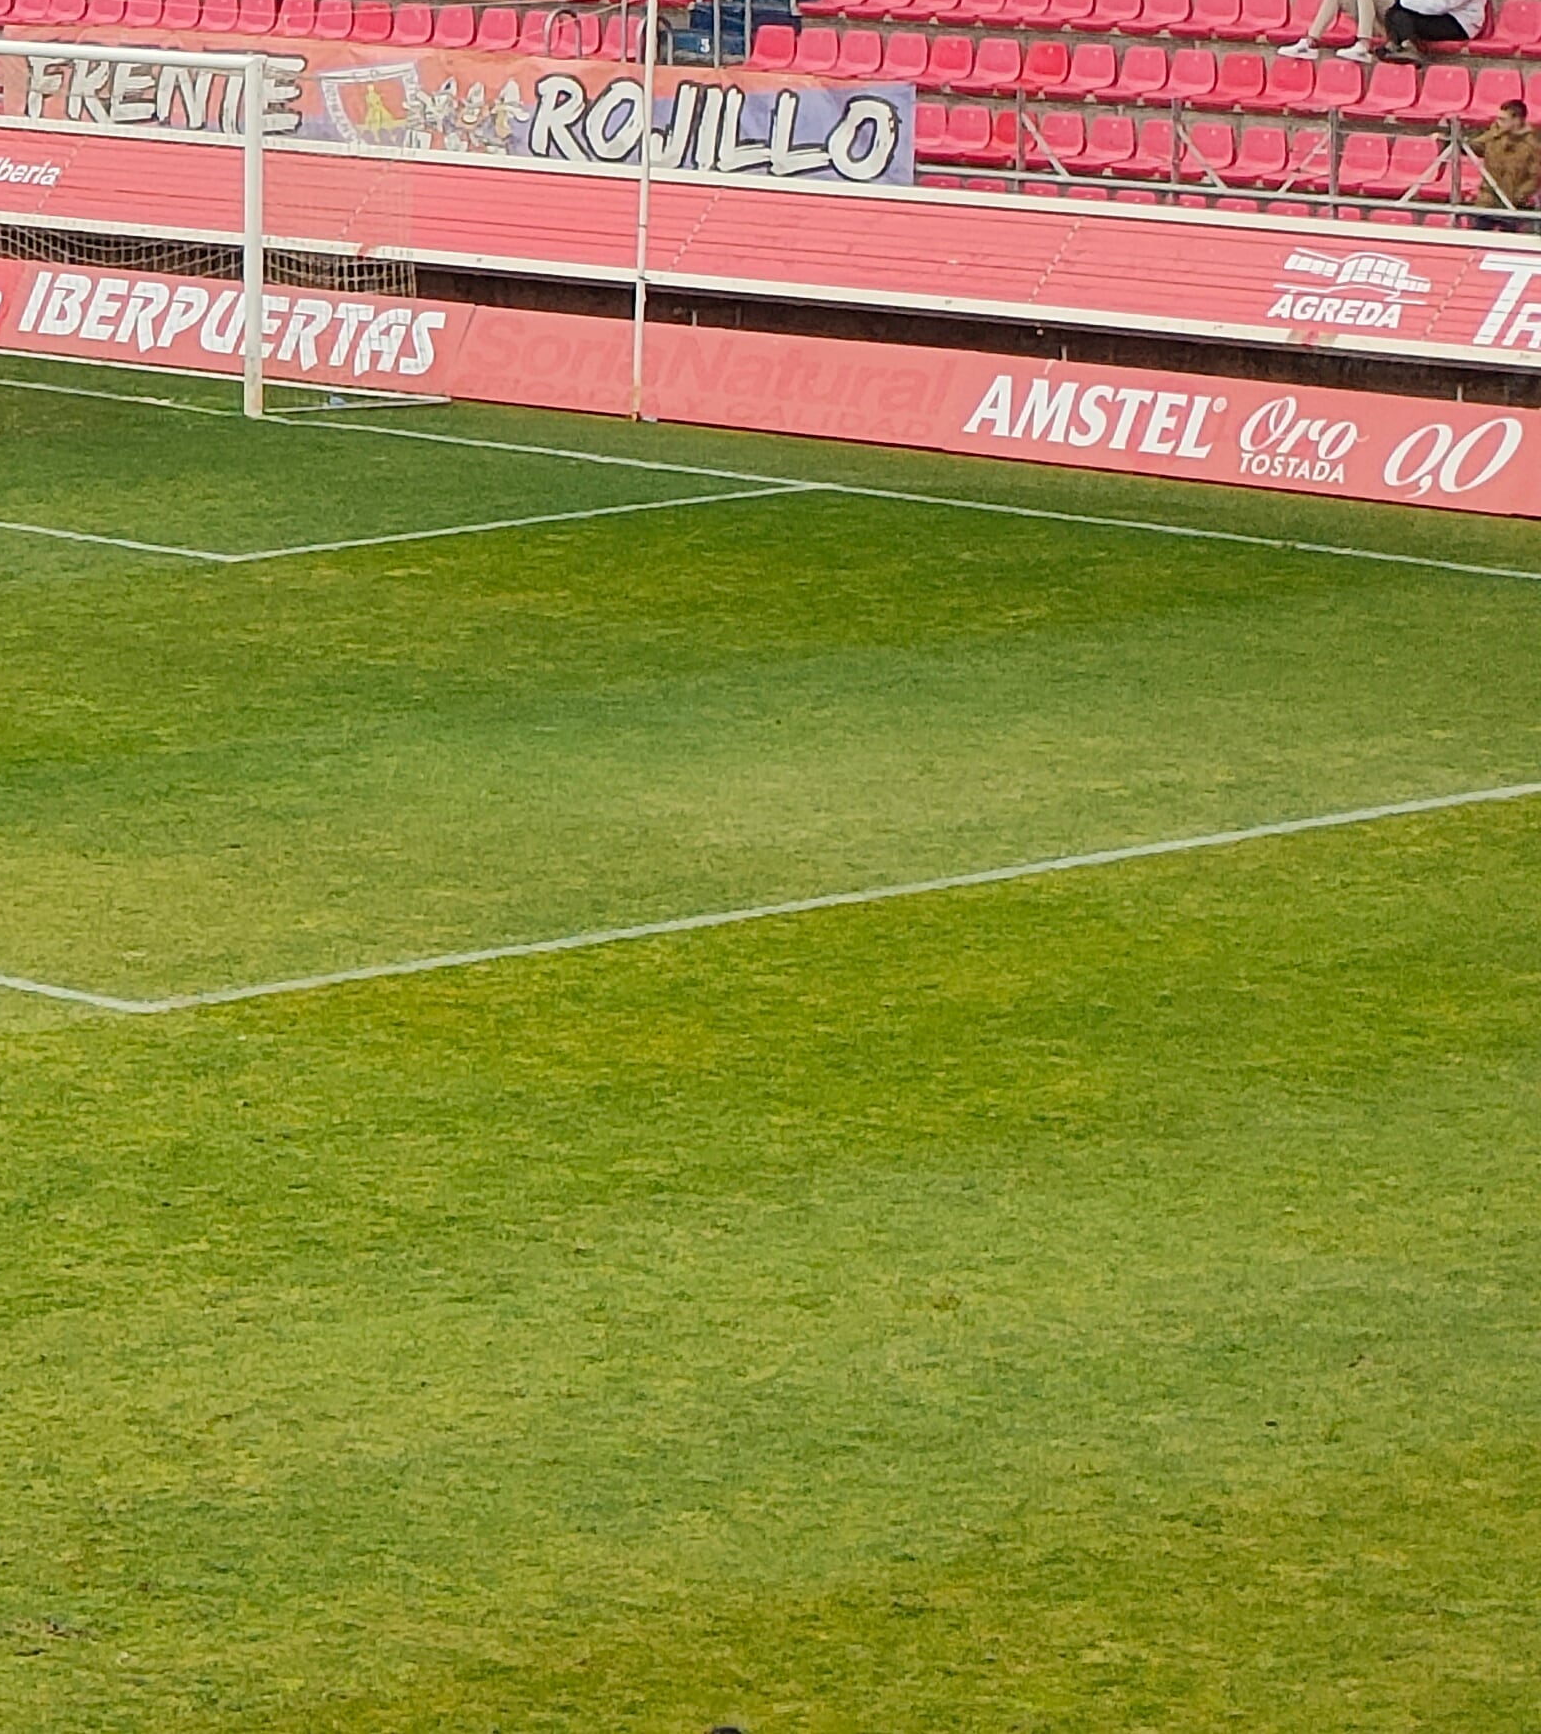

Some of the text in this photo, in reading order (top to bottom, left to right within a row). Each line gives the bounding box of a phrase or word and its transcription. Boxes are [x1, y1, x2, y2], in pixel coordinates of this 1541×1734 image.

[27, 52, 307, 136] FRENTE
[529, 73, 902, 181] ROJILLO
[18, 270, 445, 377] IBERPUERTAS
[1240, 396, 1365, 463] Oro
[1240, 452, 1345, 484] TOSTADA
